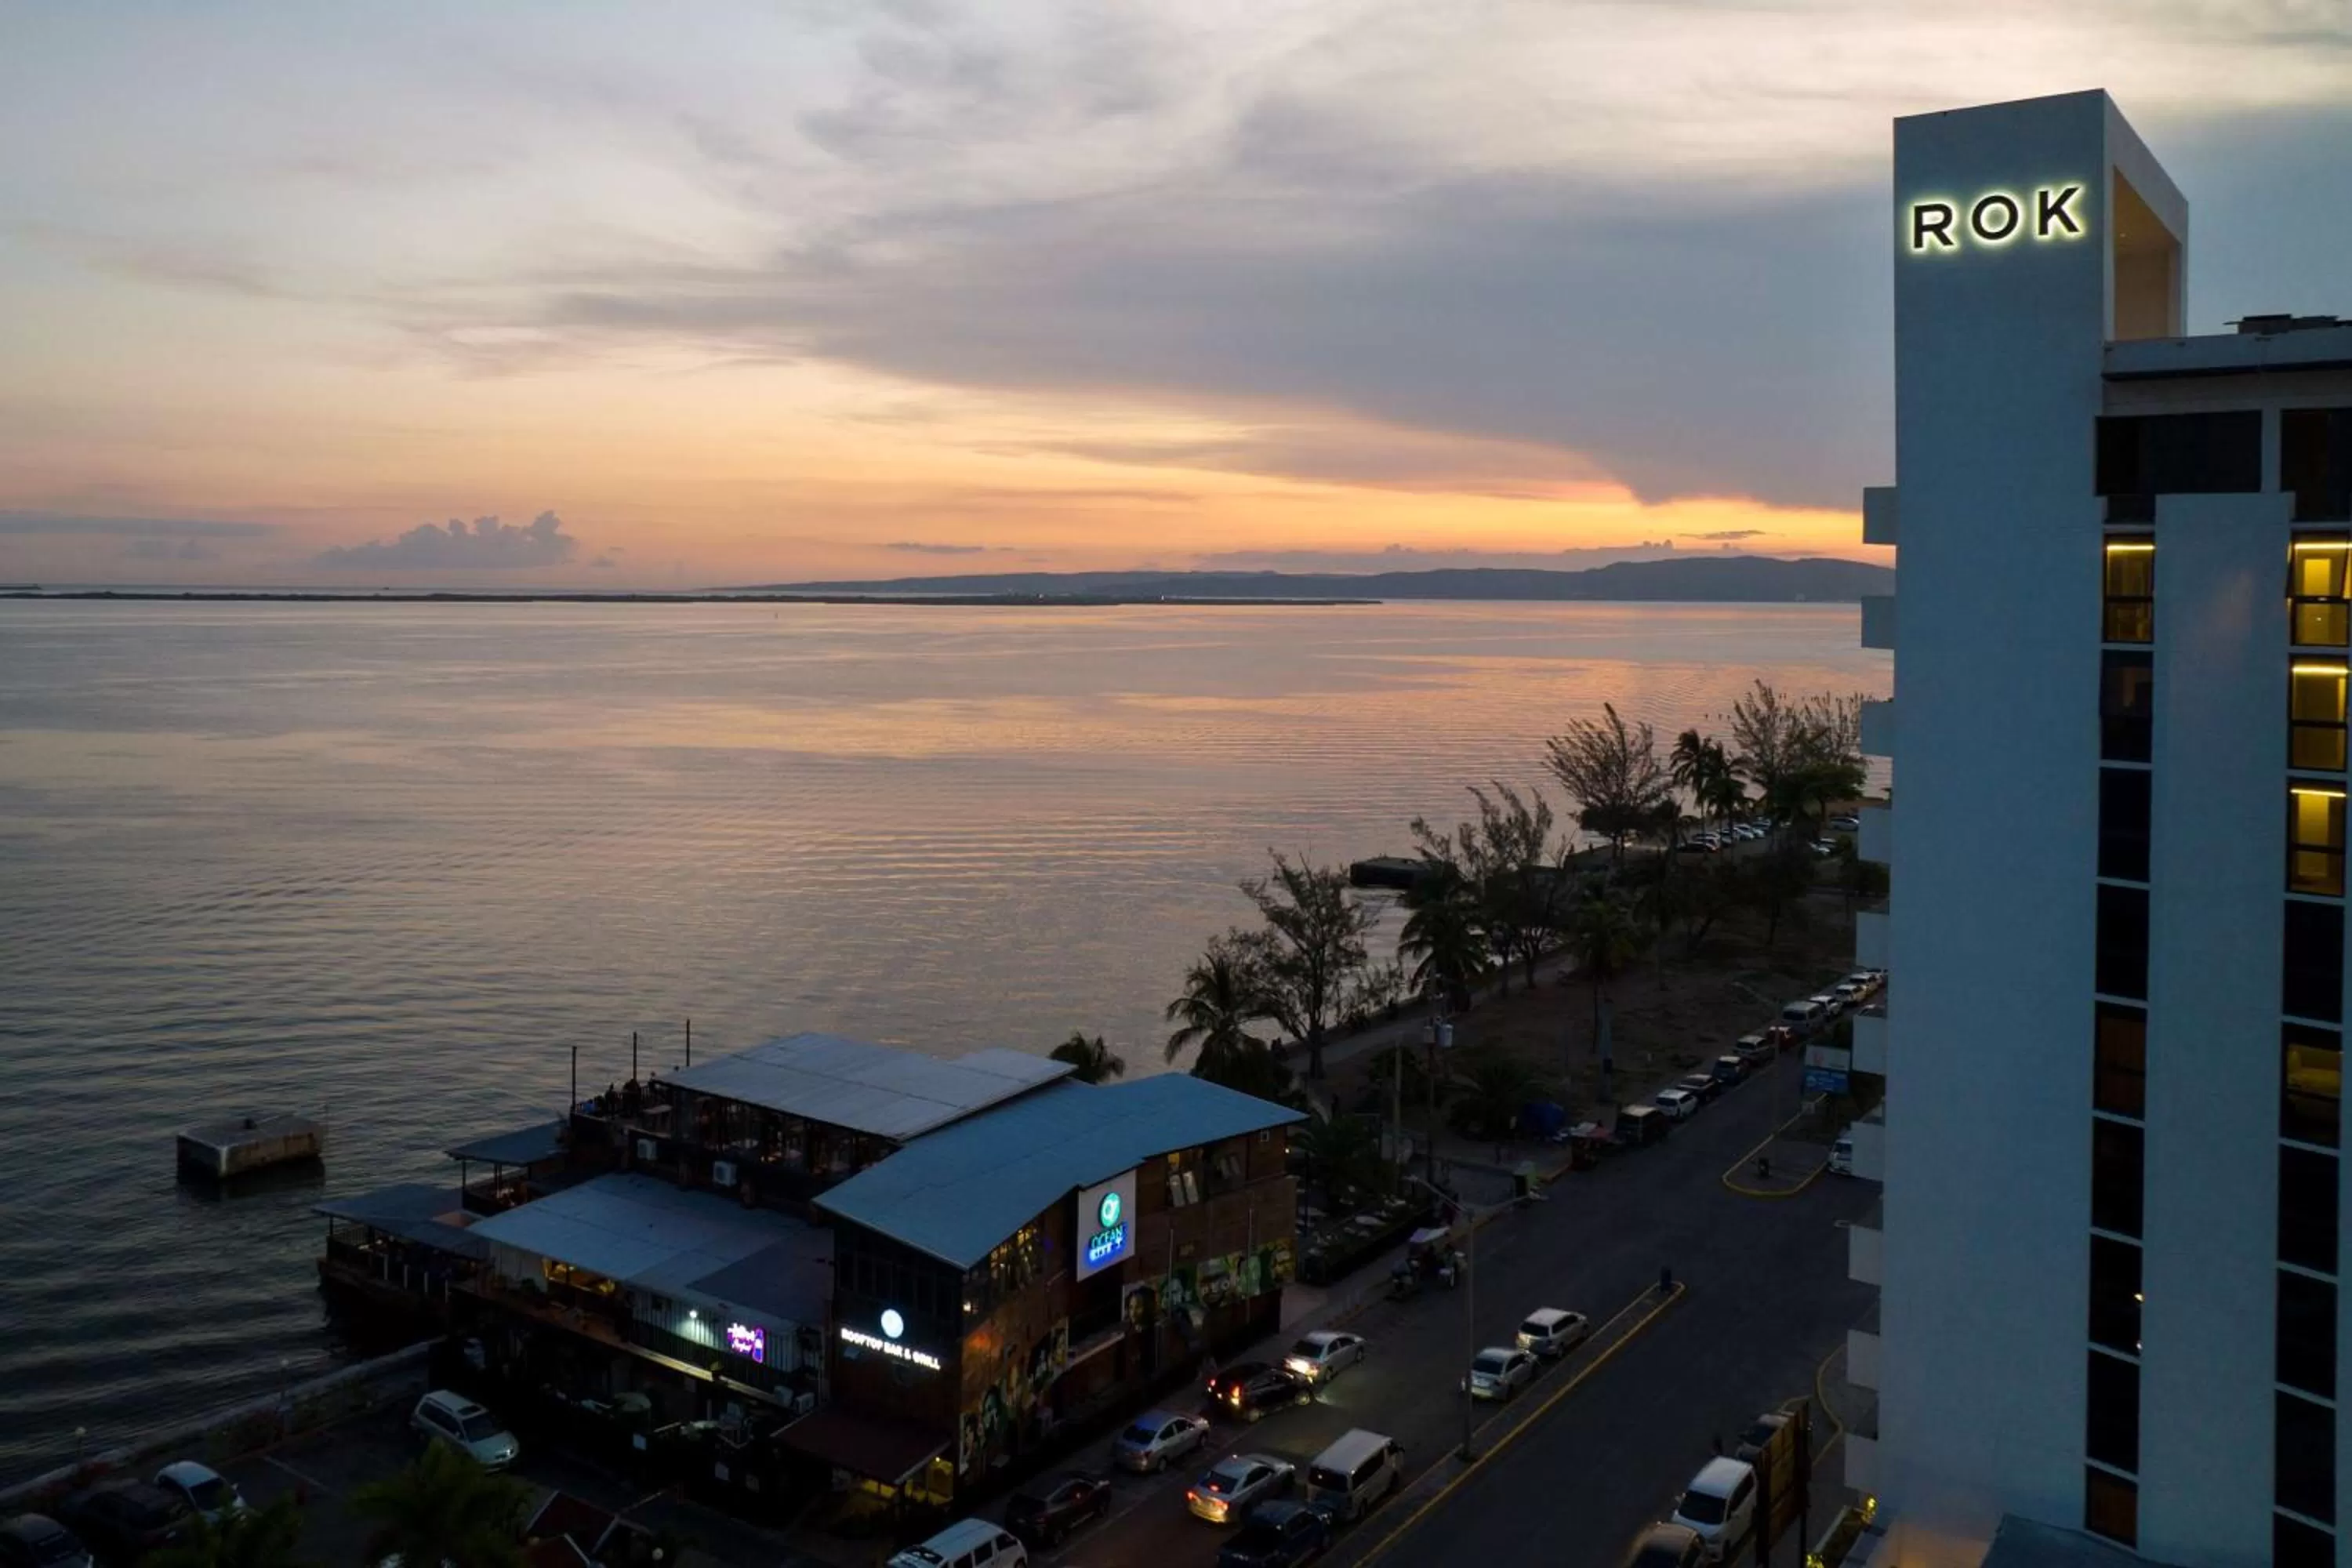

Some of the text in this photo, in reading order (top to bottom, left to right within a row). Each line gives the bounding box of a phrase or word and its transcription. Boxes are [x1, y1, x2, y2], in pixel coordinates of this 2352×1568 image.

[1914, 187, 2081, 249] ROK
[1091, 1224, 1123, 1249] OCEAN
[884, 1342, 902, 1357] BAR
